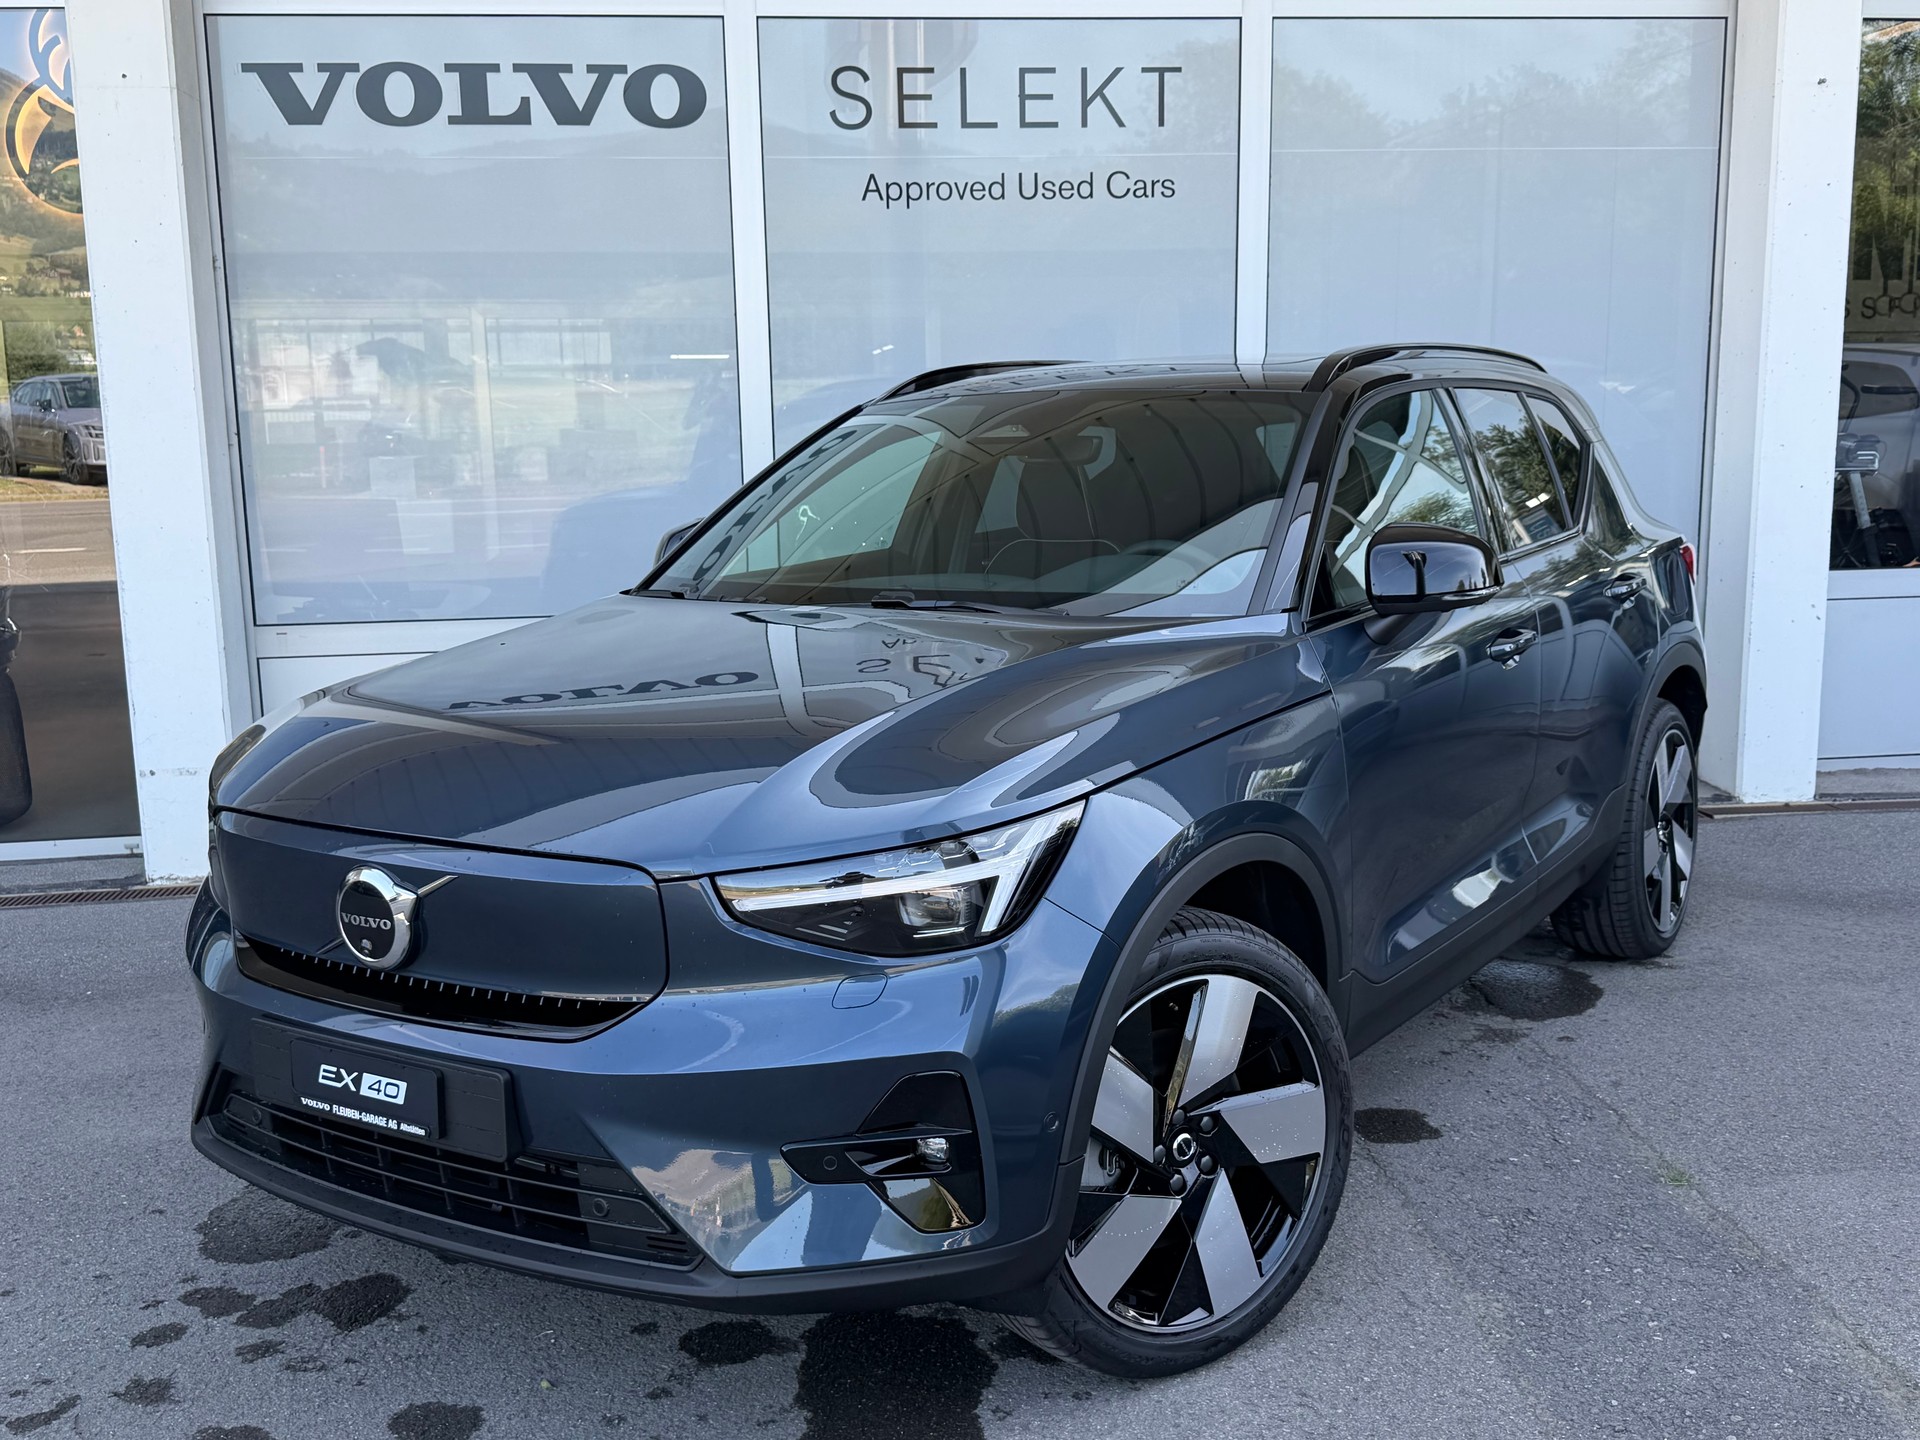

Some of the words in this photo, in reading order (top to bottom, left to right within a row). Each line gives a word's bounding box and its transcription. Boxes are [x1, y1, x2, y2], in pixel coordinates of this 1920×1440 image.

[241, 62, 707, 129] VOLVO
[829, 66, 1183, 130] SELEKT
[861, 172, 1006, 209] Approved
[1018, 171, 1094, 201] Used
[1106, 170, 1176, 200] Cars
[341, 912, 392, 930] VOLVO
[300, 1097, 331, 1111] VOLVO
[388, 1118, 398, 1130] AG
